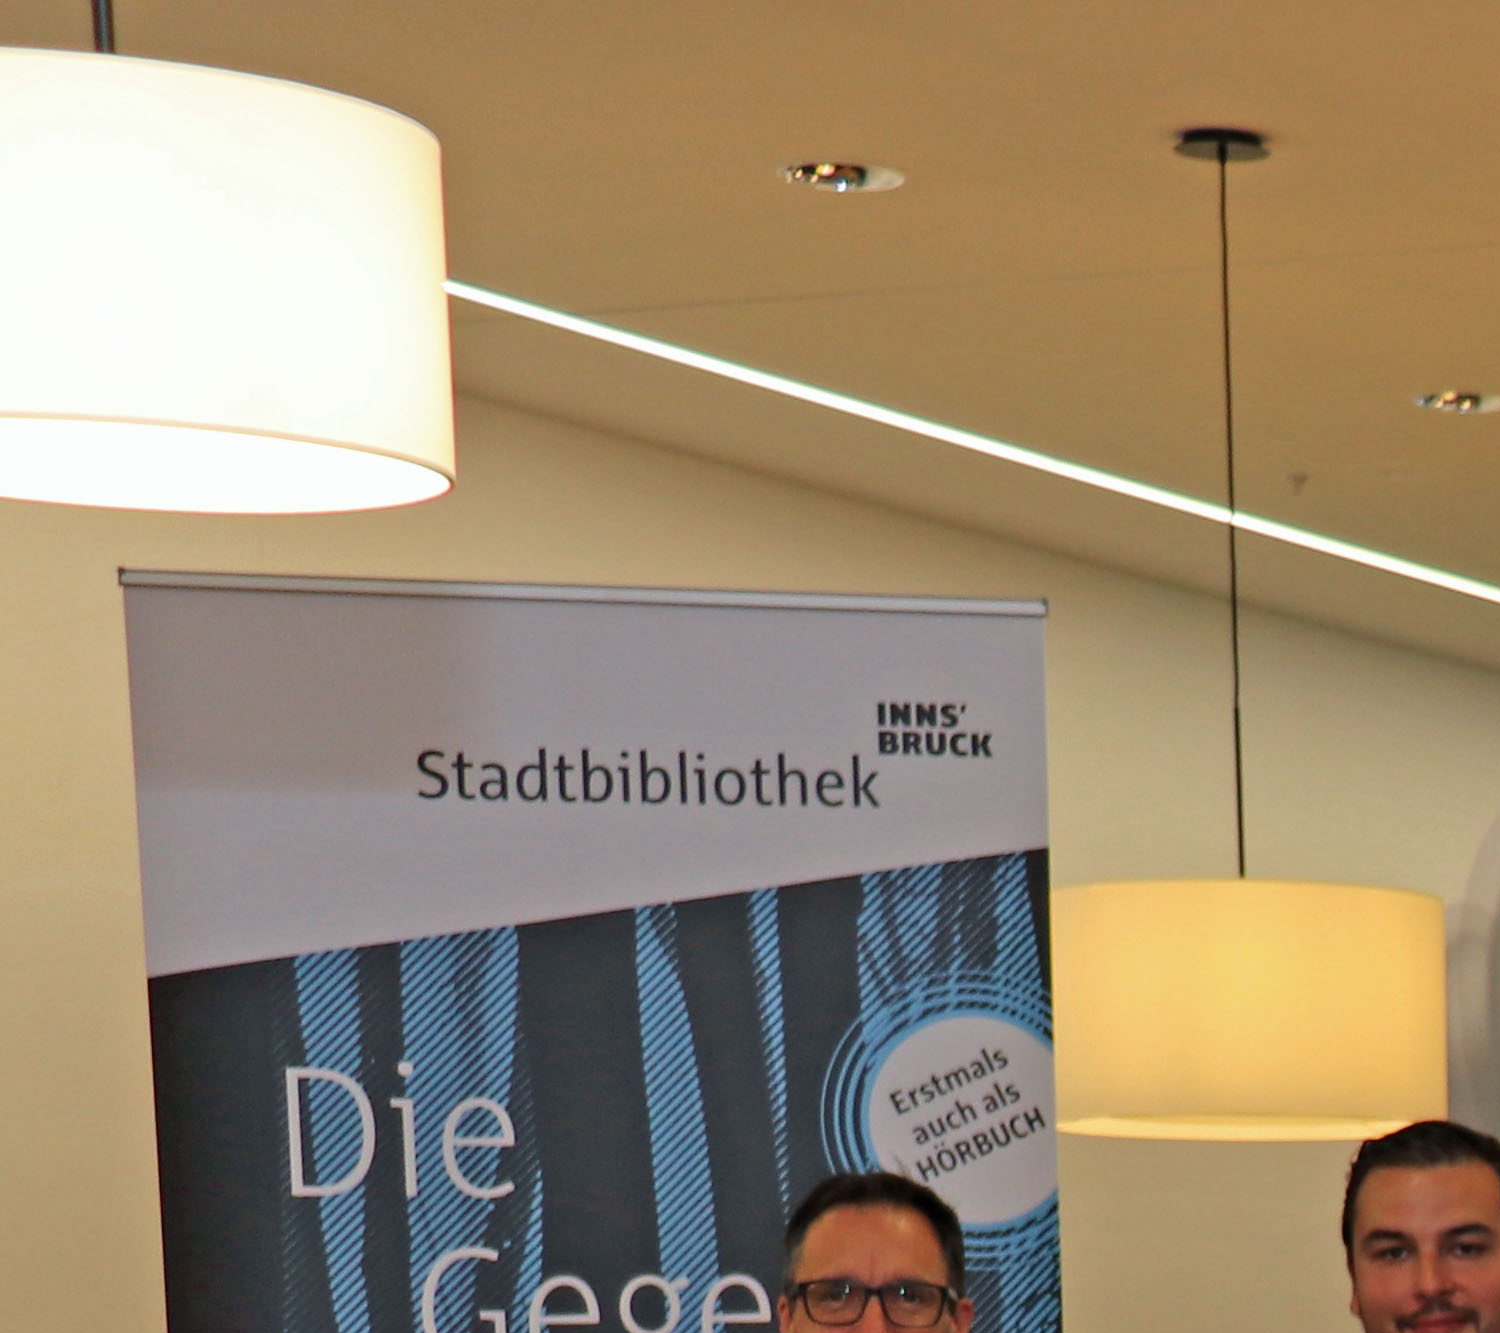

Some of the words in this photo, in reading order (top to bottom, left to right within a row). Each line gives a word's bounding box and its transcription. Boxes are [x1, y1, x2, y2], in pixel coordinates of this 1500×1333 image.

[877, 730, 993, 757] BRUCK
[417, 748, 880, 808] Stadtbibliothek
[890, 1048, 1008, 1115] Erstmals
[285, 1063, 517, 1198] Die
[912, 1102, 977, 1145] auch
[984, 1083, 1021, 1113] als
[917, 1106, 1046, 1182] HÖRBUCH
